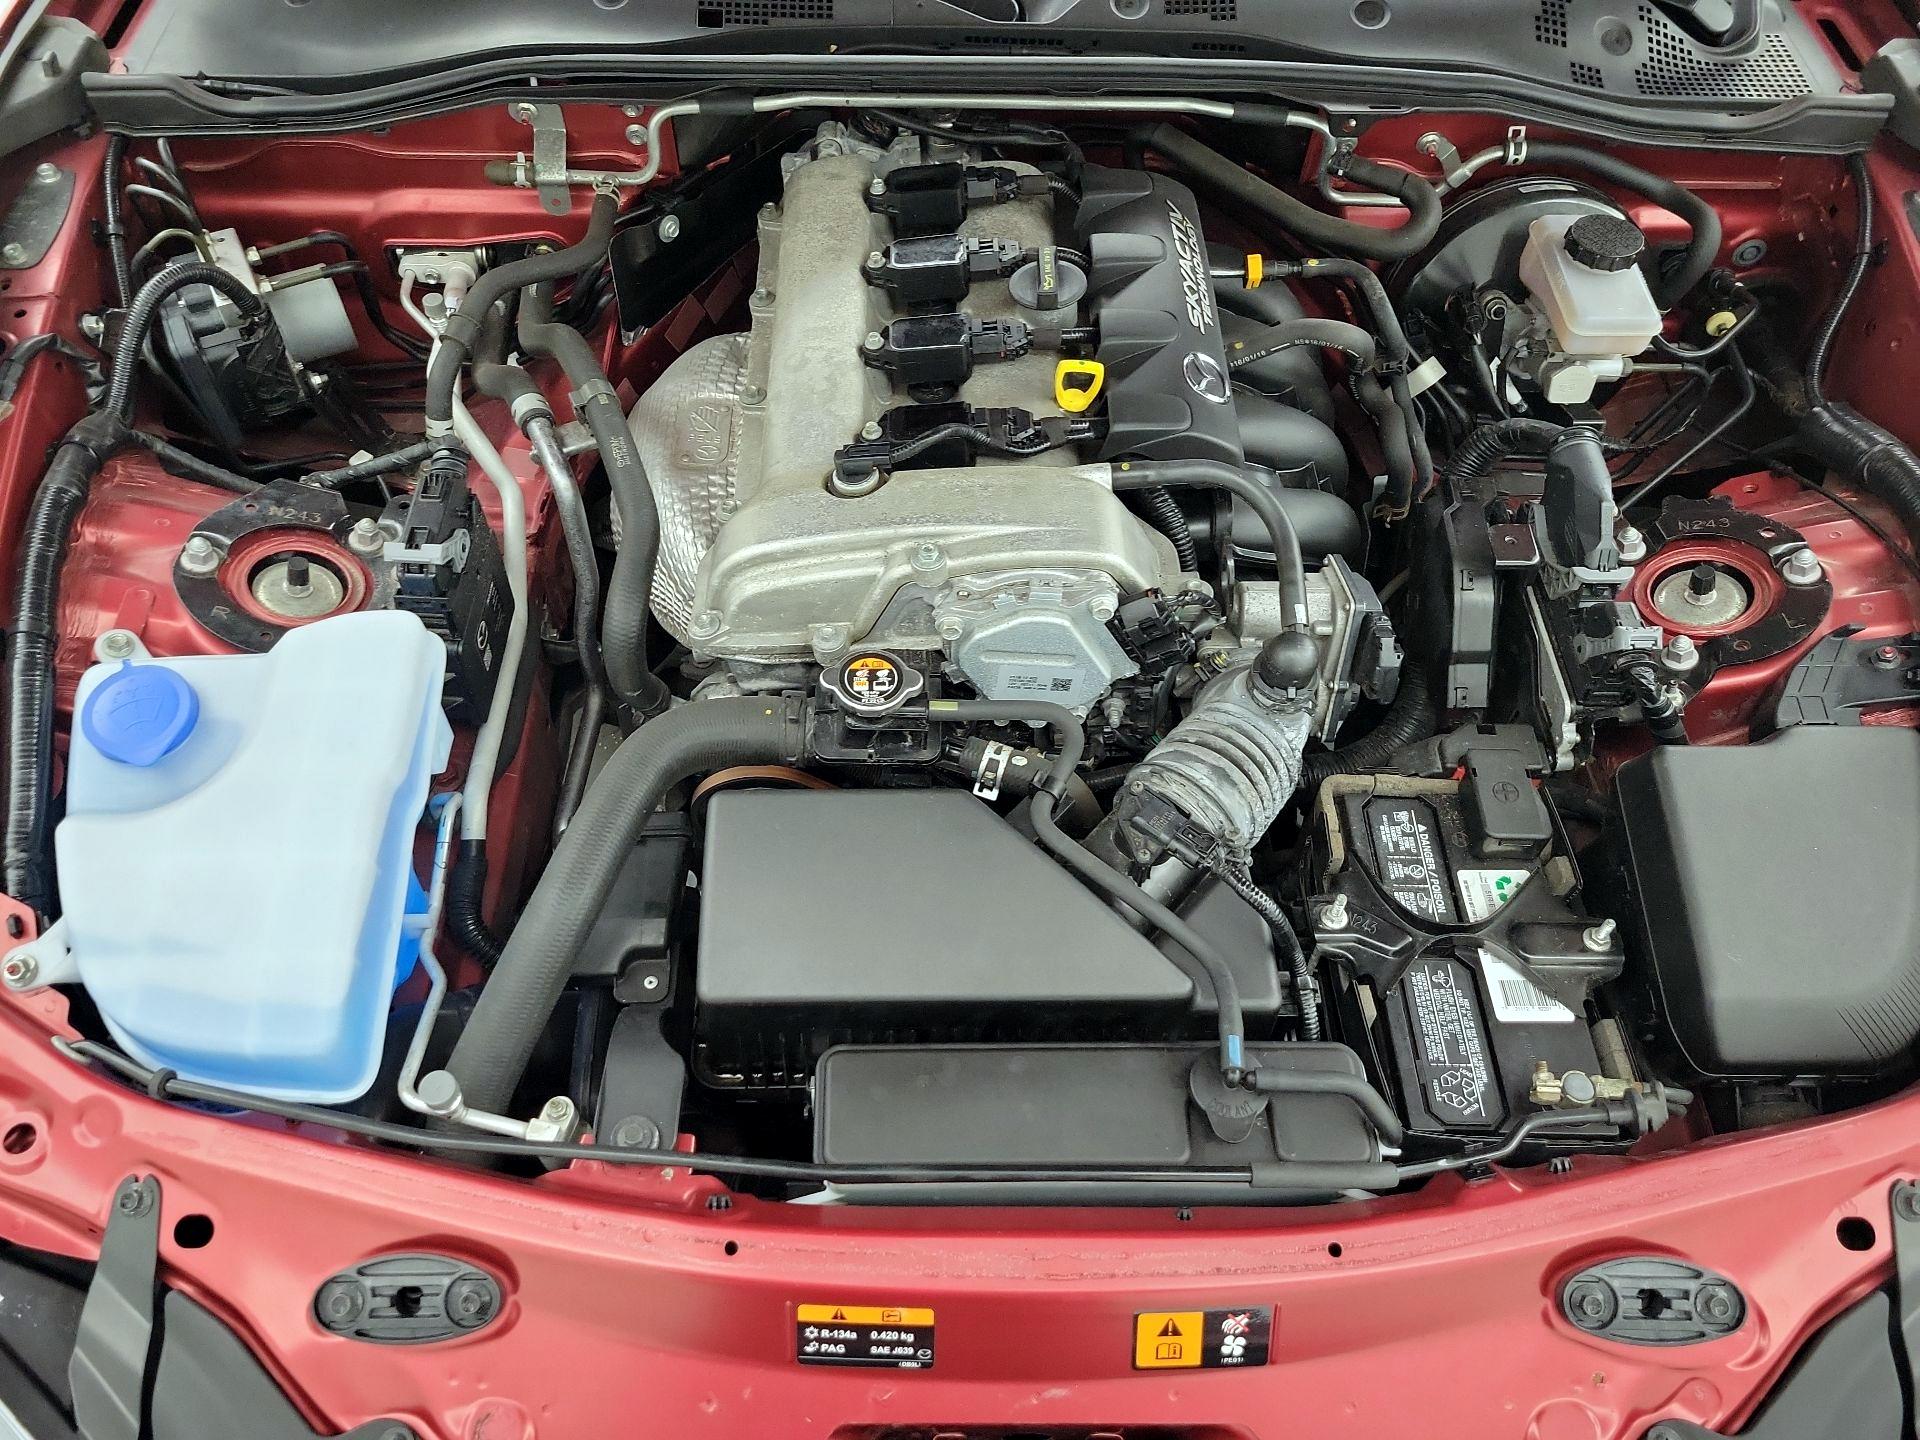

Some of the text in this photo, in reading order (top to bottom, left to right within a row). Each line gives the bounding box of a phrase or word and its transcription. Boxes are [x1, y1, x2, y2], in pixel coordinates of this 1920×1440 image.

[1166, 199, 1206, 335] SKYACTIV
[1183, 216, 1214, 327] TECHNOLOGY
[1678, 518, 1730, 531] N243
[1419, 833, 1436, 870] DANGER
[1429, 877, 1446, 913] POISON
[821, 1329, 914, 1342] R-134a 0.420 kg
[821, 1344, 914, 1354] PAG SAE J639
